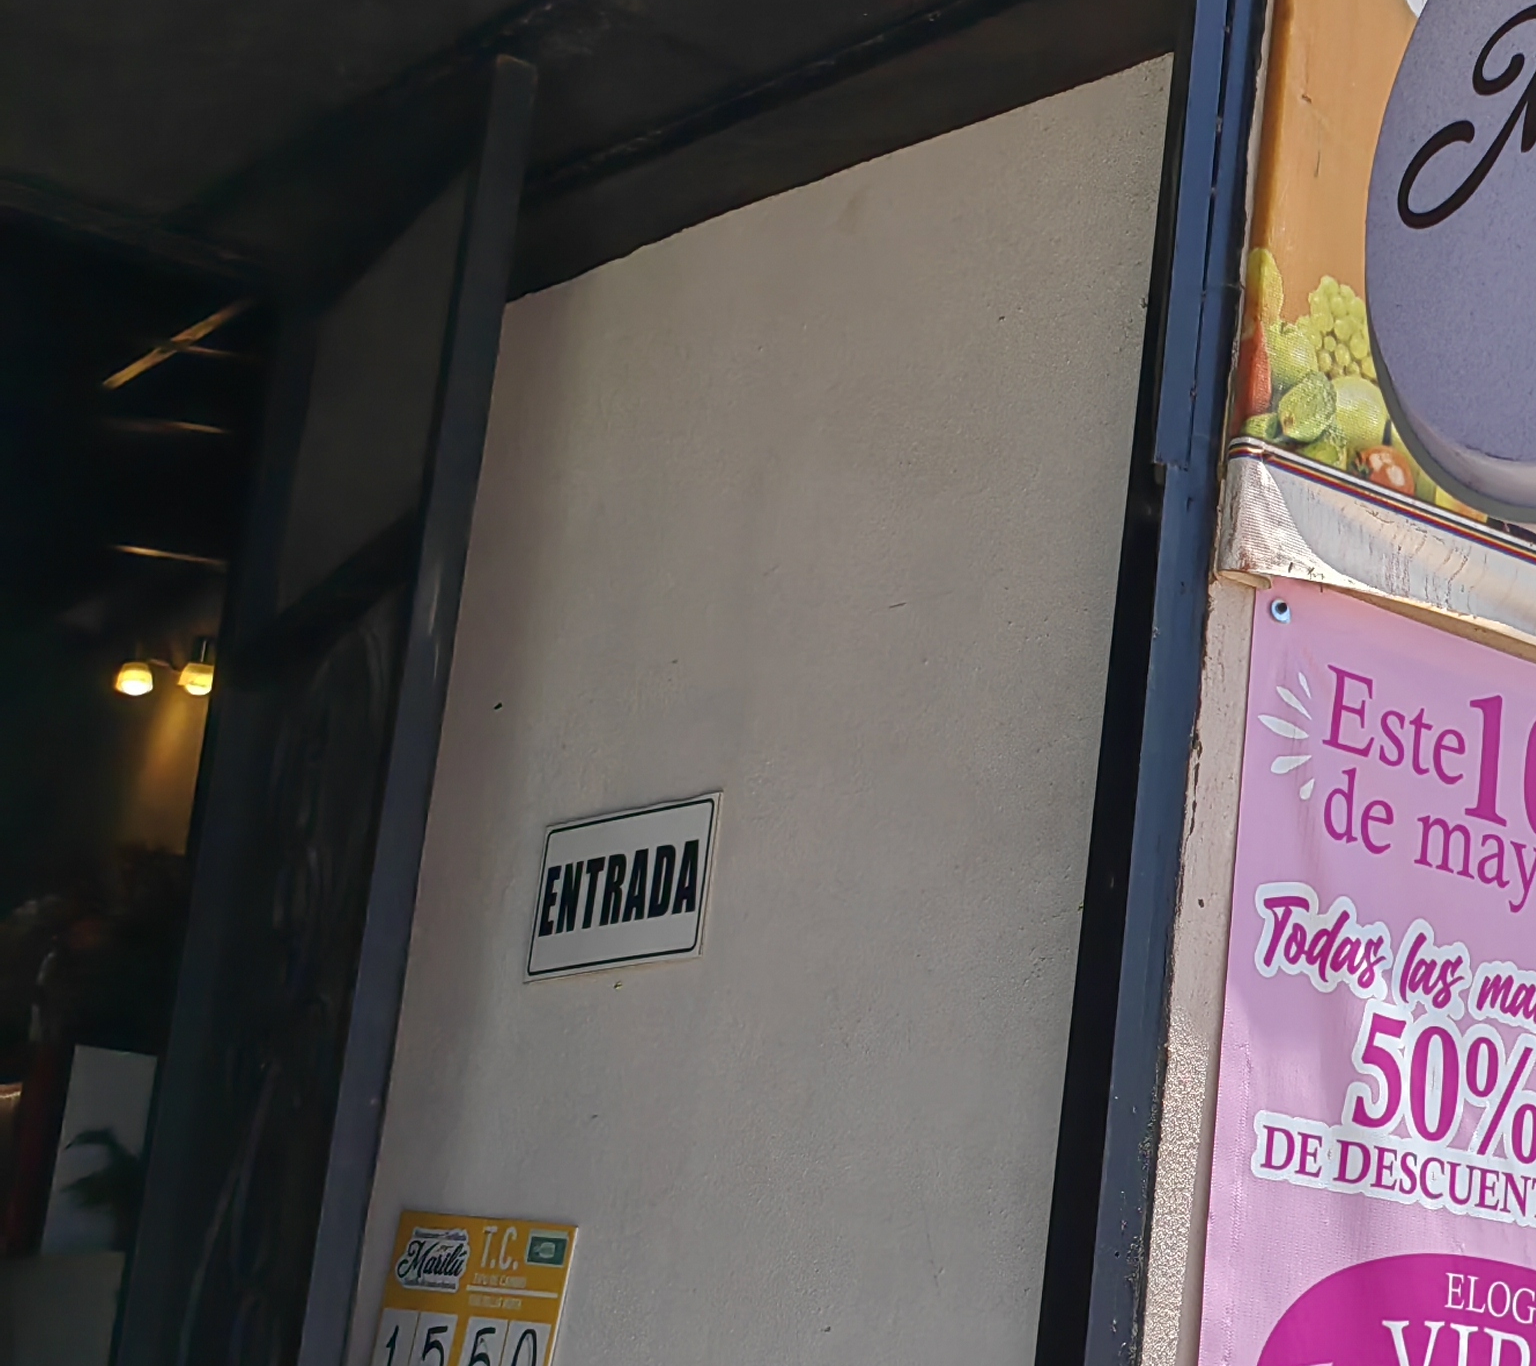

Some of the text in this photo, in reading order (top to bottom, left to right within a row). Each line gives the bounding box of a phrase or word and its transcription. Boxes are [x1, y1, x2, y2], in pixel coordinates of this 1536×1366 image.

[1322, 664, 1466, 784] Este
[1324, 767, 1394, 854] de
[538, 840, 700, 937] ENTRADA
[1264, 896, 1386, 988] Todas
[1400, 932, 1464, 1009] las
[1260, 1125, 1323, 1178] DE
[397, 1240, 467, 1279] Marilú
